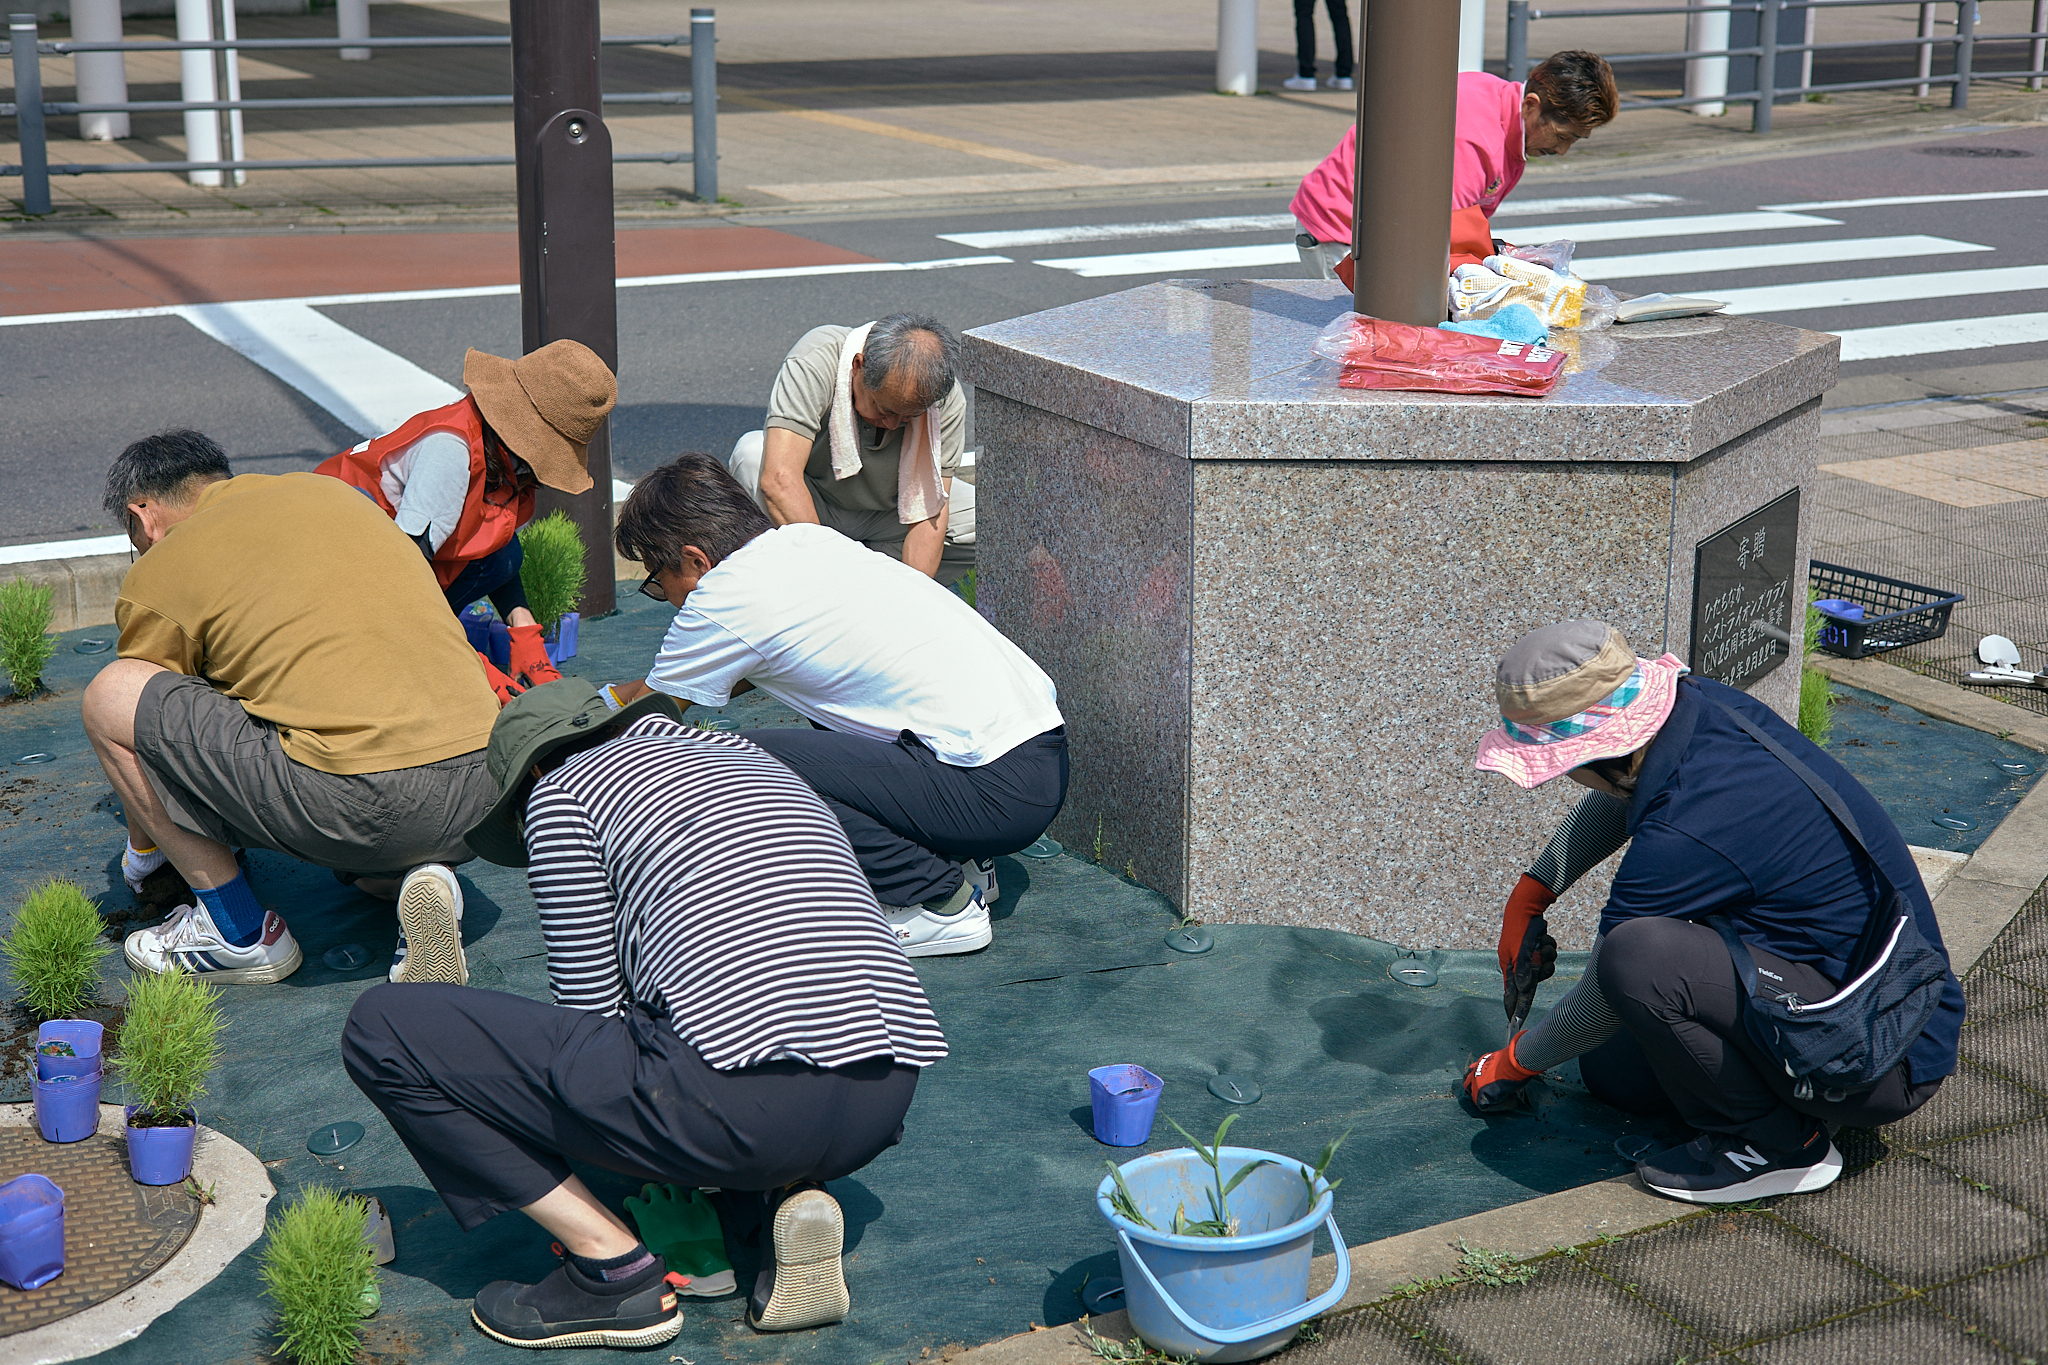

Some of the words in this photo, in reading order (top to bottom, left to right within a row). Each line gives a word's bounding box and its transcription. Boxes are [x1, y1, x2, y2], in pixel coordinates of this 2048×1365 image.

[1736, 526, 1766, 570] 寄贈
[1702, 574, 1789, 644] ベストライオンズクラブ
[1704, 582, 1745, 624] ひたちなか
[1702, 601, 1785, 675] CN25周年記念事業
[1712, 638, 1778, 687] 和2年2月22日
[1724, 1144, 1770, 1173] N
